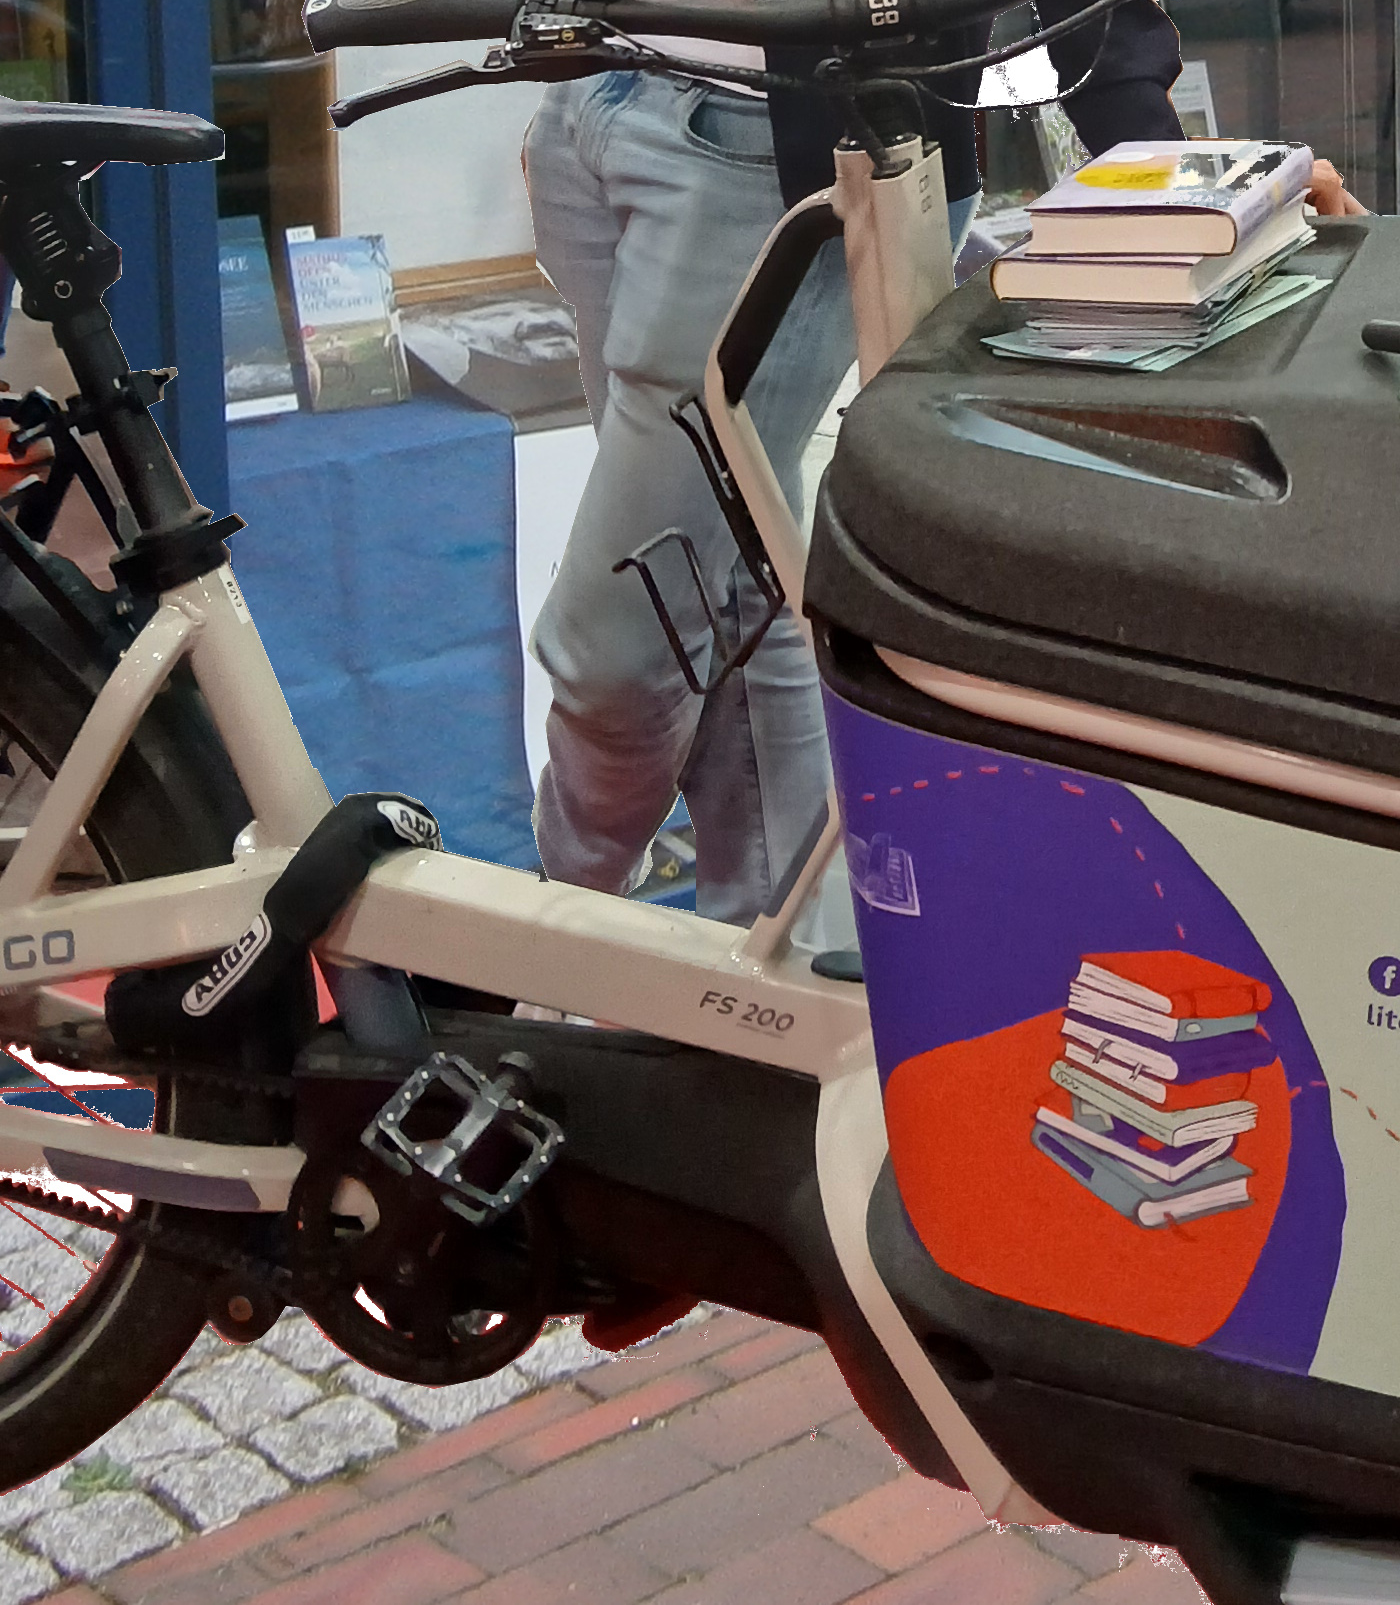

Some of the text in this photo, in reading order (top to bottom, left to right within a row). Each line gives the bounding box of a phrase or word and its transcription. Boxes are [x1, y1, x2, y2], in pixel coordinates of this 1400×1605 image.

[193, 930, 258, 1004] ABUS
[699, 990, 795, 1032] FS 200
